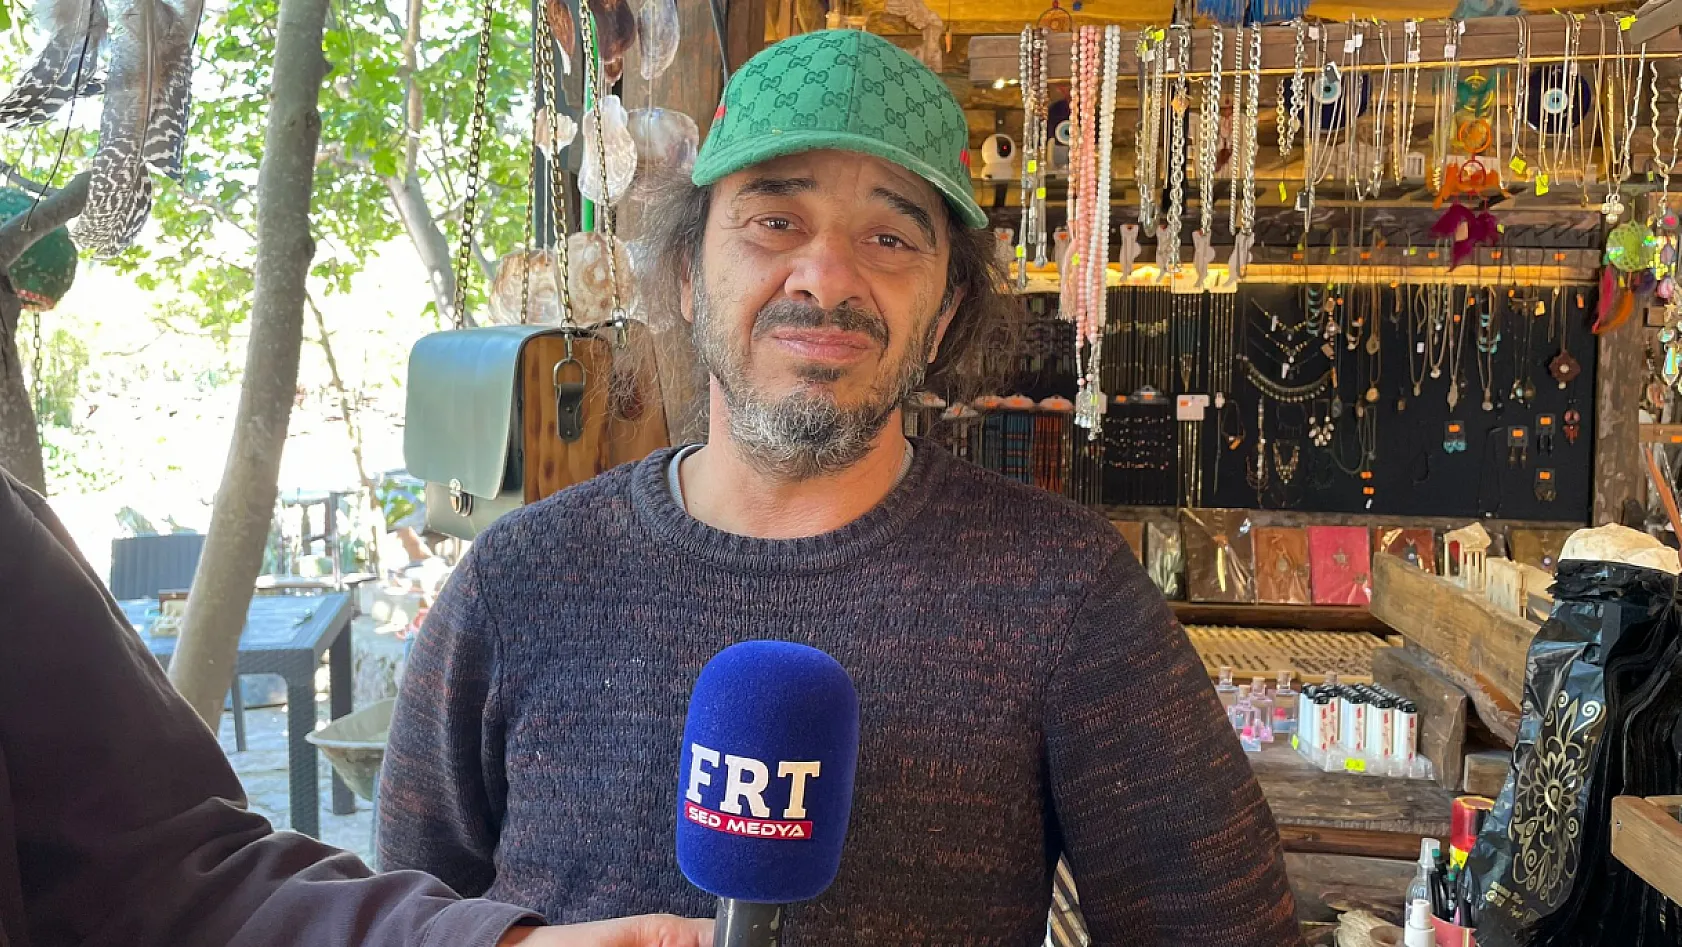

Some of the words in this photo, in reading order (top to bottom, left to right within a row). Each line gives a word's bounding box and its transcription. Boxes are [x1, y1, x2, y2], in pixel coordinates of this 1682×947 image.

[686, 743, 821, 819] FRT
[688, 806, 721, 828] SED
[726, 818, 805, 837] MEDYA
